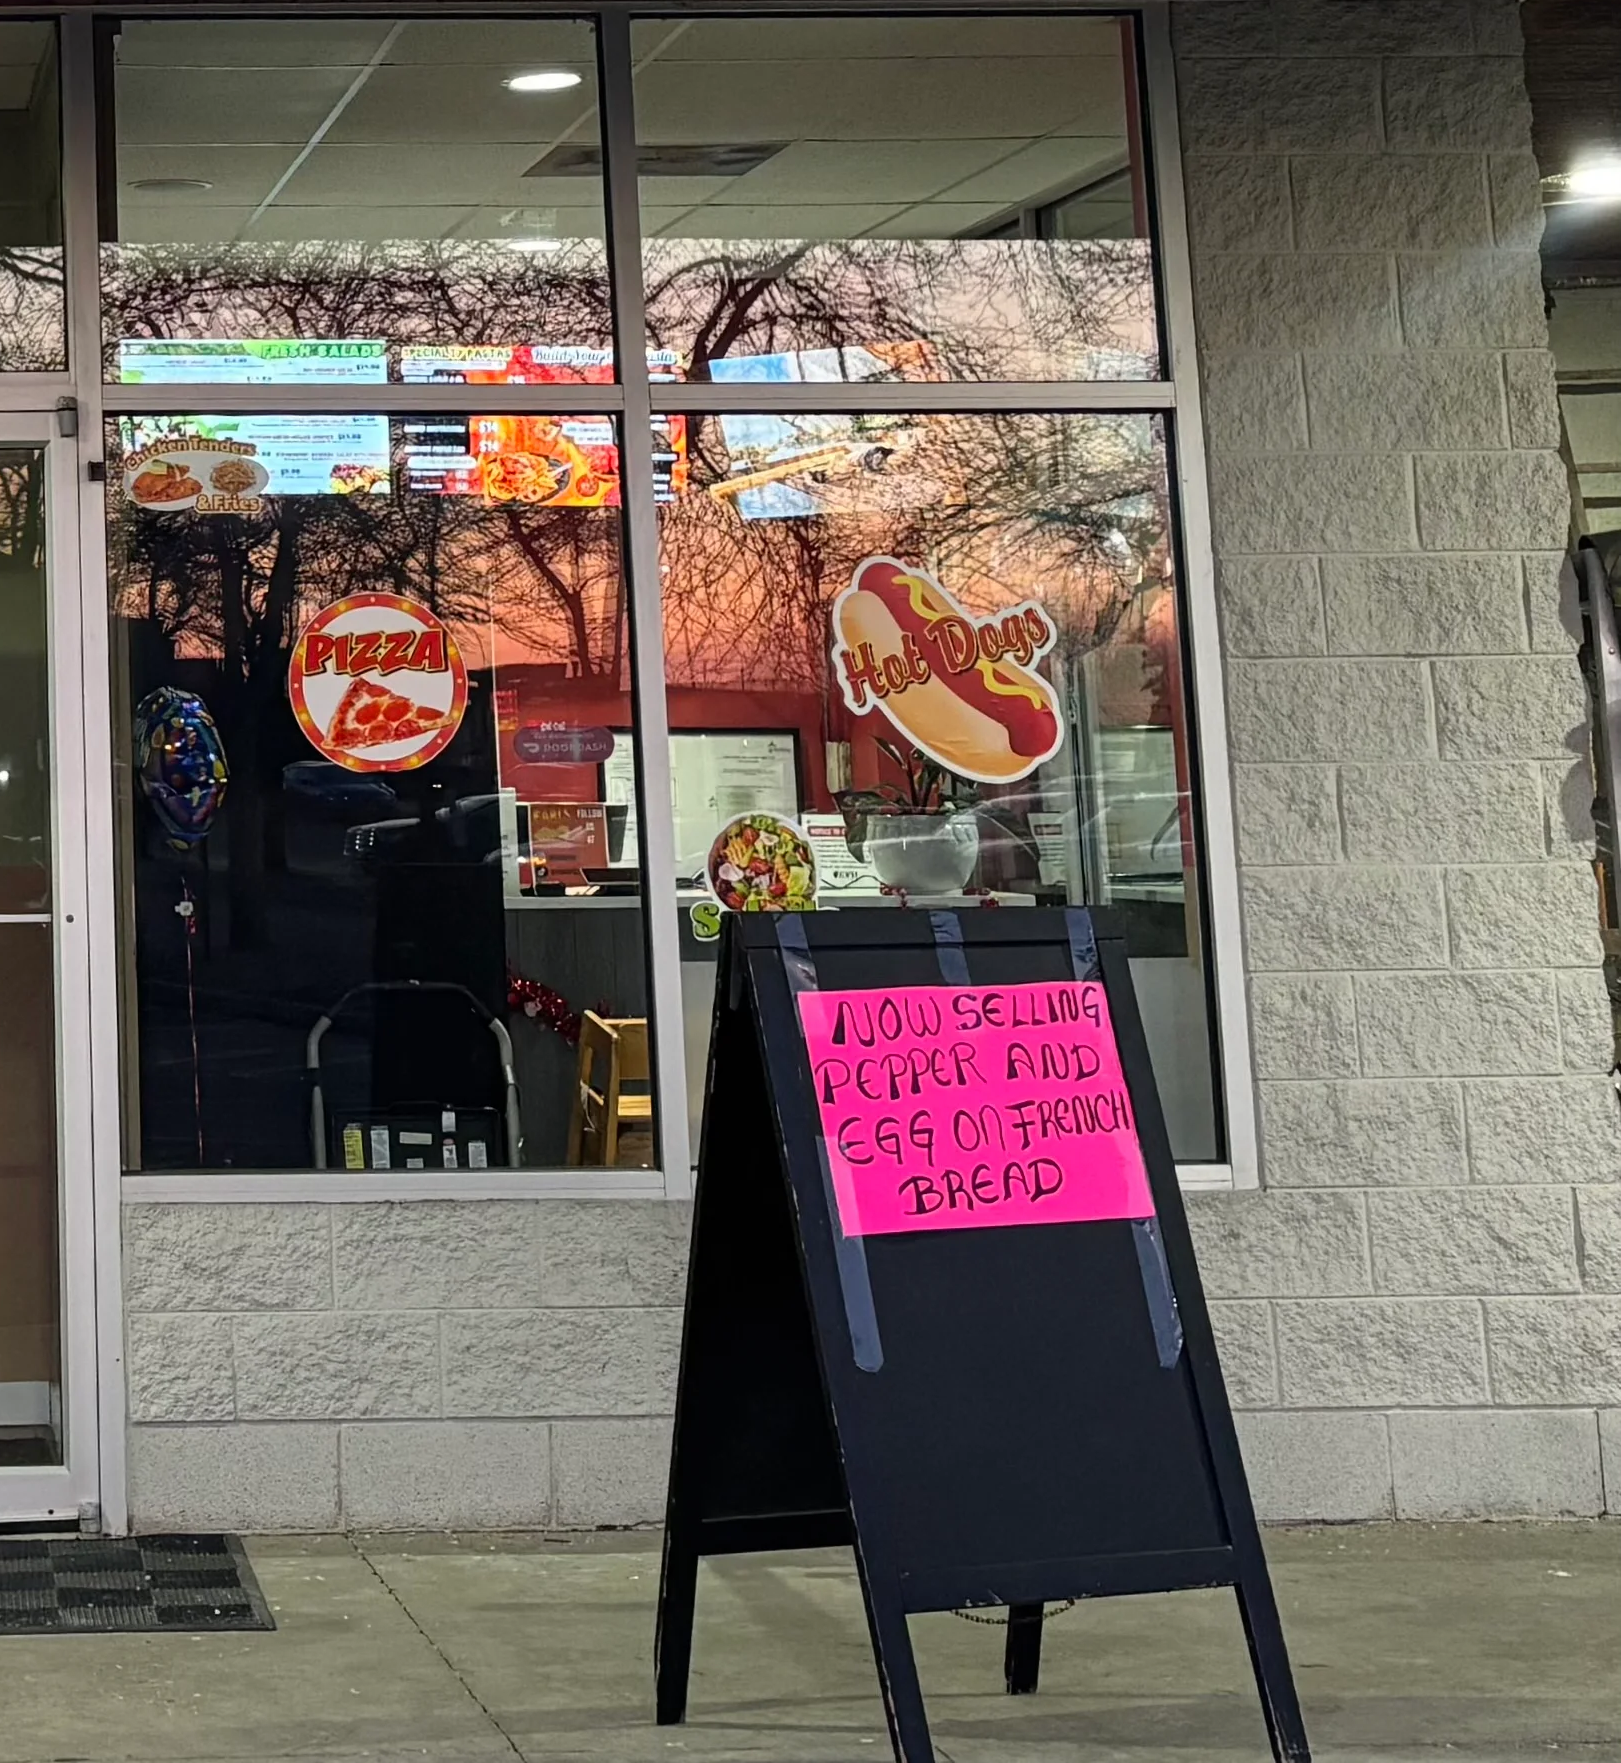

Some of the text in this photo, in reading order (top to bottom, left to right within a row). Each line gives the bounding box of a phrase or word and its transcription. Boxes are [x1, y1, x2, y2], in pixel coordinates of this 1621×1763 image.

[260, 343, 383, 358] FRESH SALADS
[124, 437, 257, 471] Chicken Tenders
[196, 494, 261, 511] & Fries
[301, 628, 448, 677] PIZZA
[840, 599, 1050, 708] Hot Dogs
[831, 987, 1102, 1047] NOW SELLING
[813, 1041, 1101, 1105] PEPPER AND
[836, 1109, 936, 1168] EGG
[1004, 1089, 1132, 1151] FRENCH
[897, 1157, 1064, 1216] BREAD
